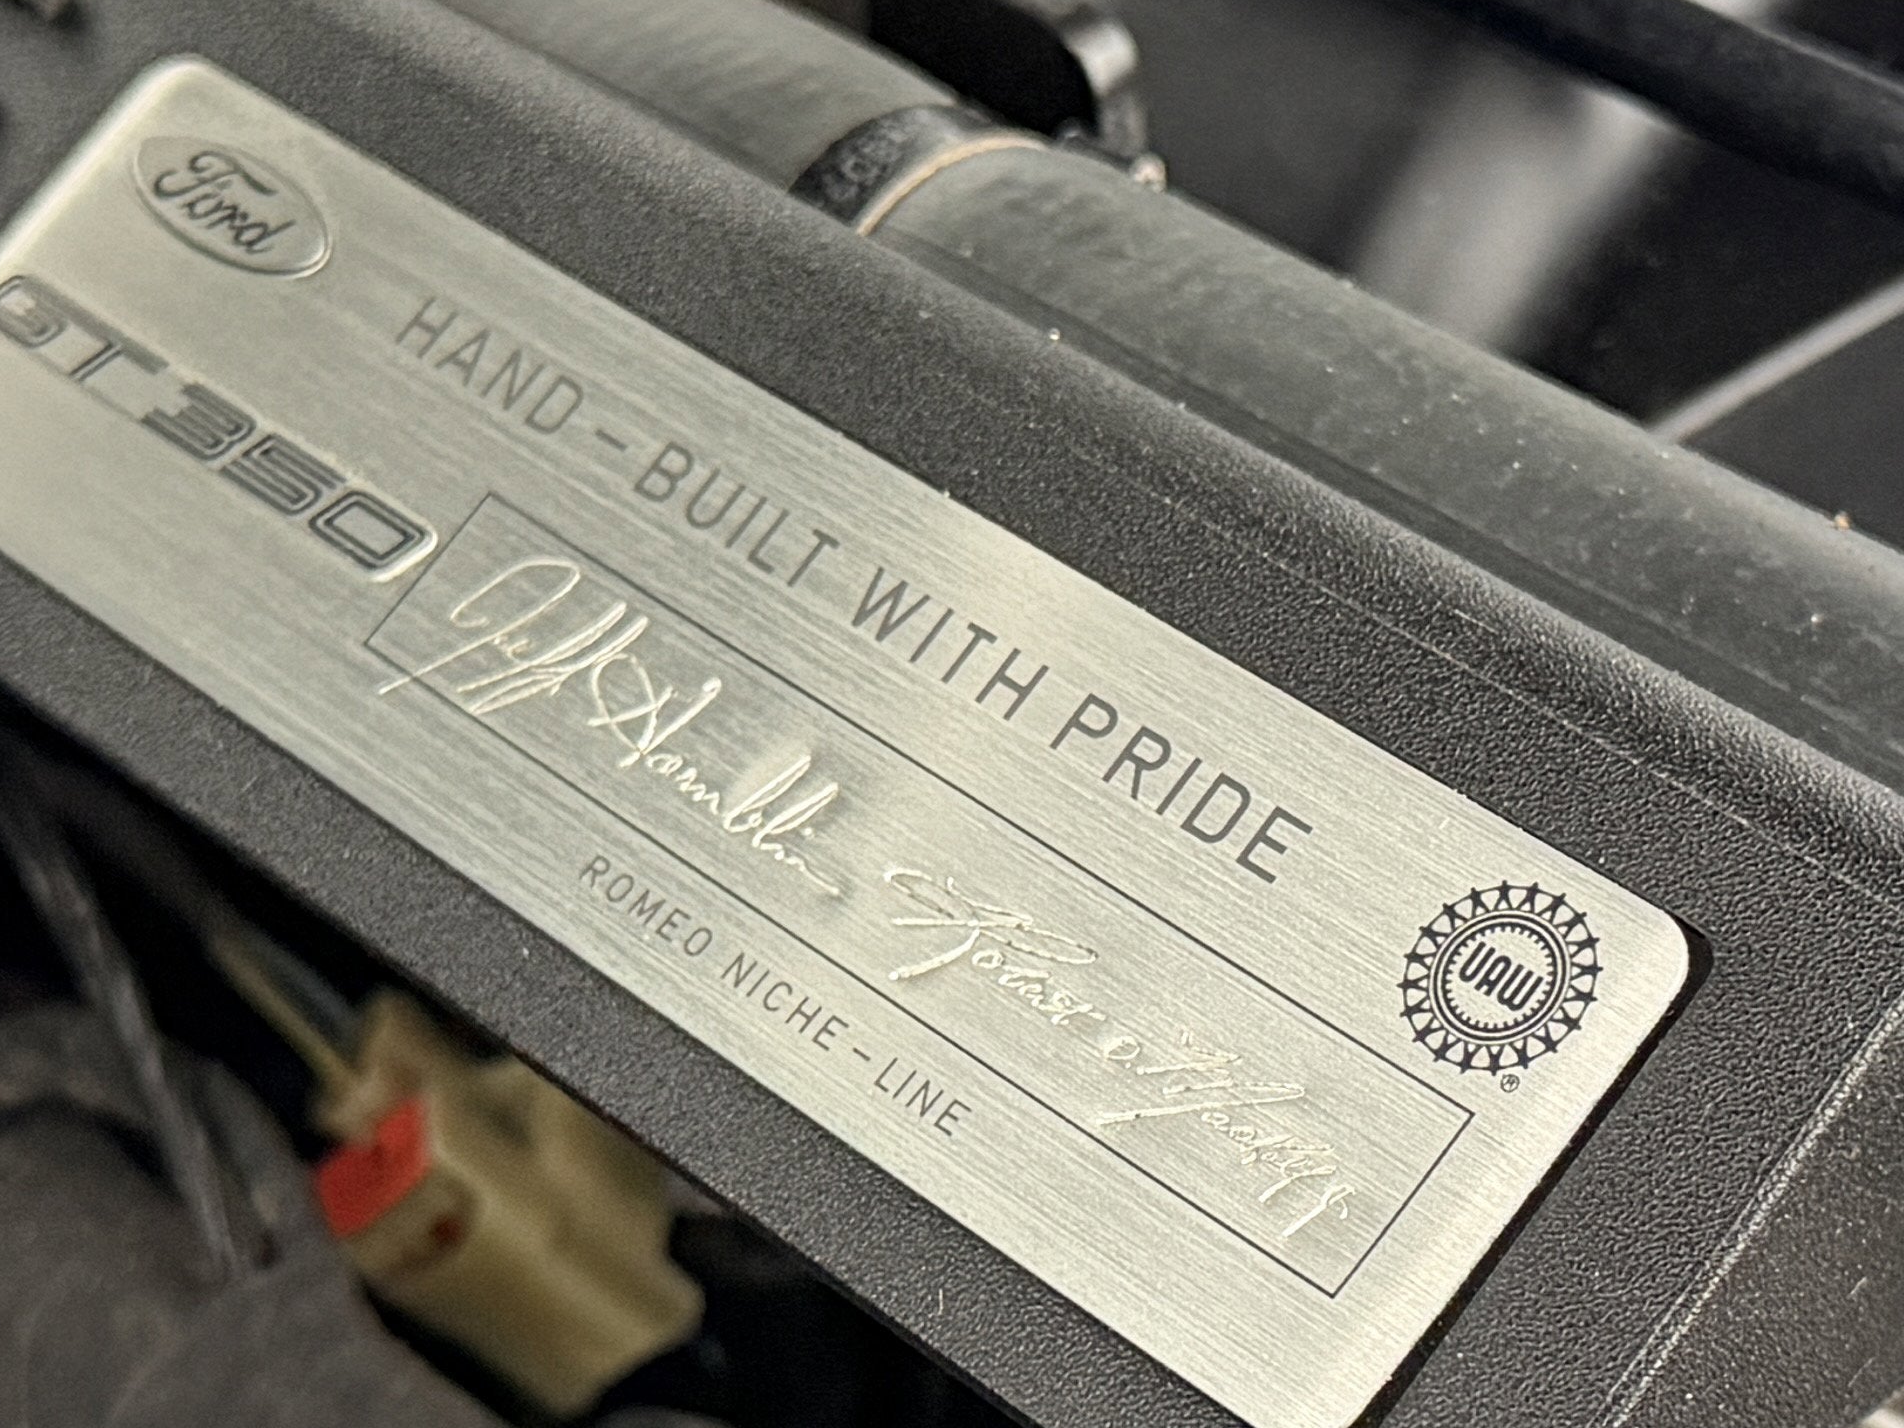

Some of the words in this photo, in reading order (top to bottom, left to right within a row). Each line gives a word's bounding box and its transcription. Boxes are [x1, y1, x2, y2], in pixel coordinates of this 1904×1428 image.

[152, 149, 299, 258] Ford
[850, 563, 1052, 724] WITH
[1049, 691, 1315, 886] PRIDE
[579, 854, 714, 957] ROMEO
[1458, 941, 1545, 1012] UAW
